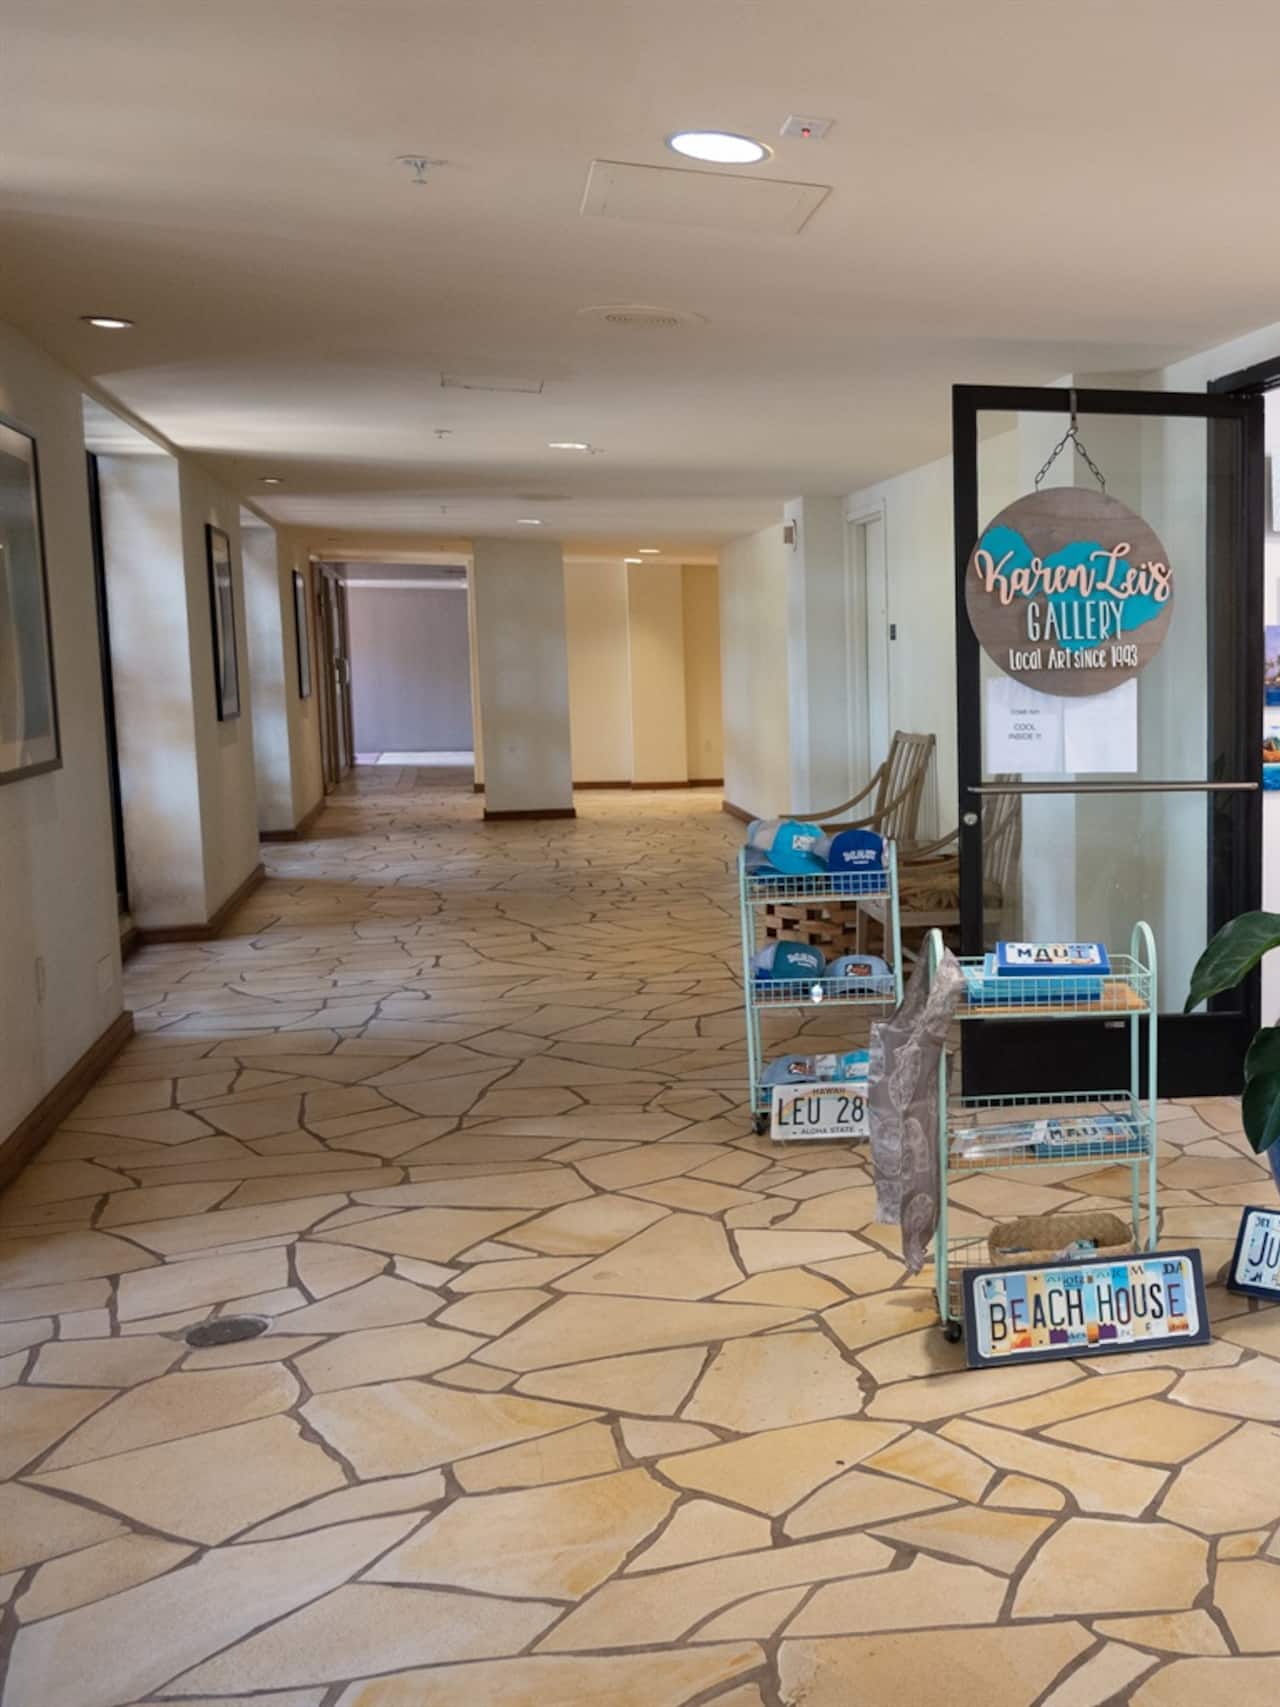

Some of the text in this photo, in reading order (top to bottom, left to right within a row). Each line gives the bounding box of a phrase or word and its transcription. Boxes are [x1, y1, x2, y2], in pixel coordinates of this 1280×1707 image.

[974, 549, 1095, 604] Karen
[1027, 600, 1125, 641] GALLERY
[1111, 644, 1138, 668] 1993
[1017, 948, 1085, 959] MAUI
[778, 1096, 865, 1126] LEU 28
[801, 1126, 854, 1135] ALOHA STATE
[989, 1283, 1184, 1341] BEACH HOUSE
